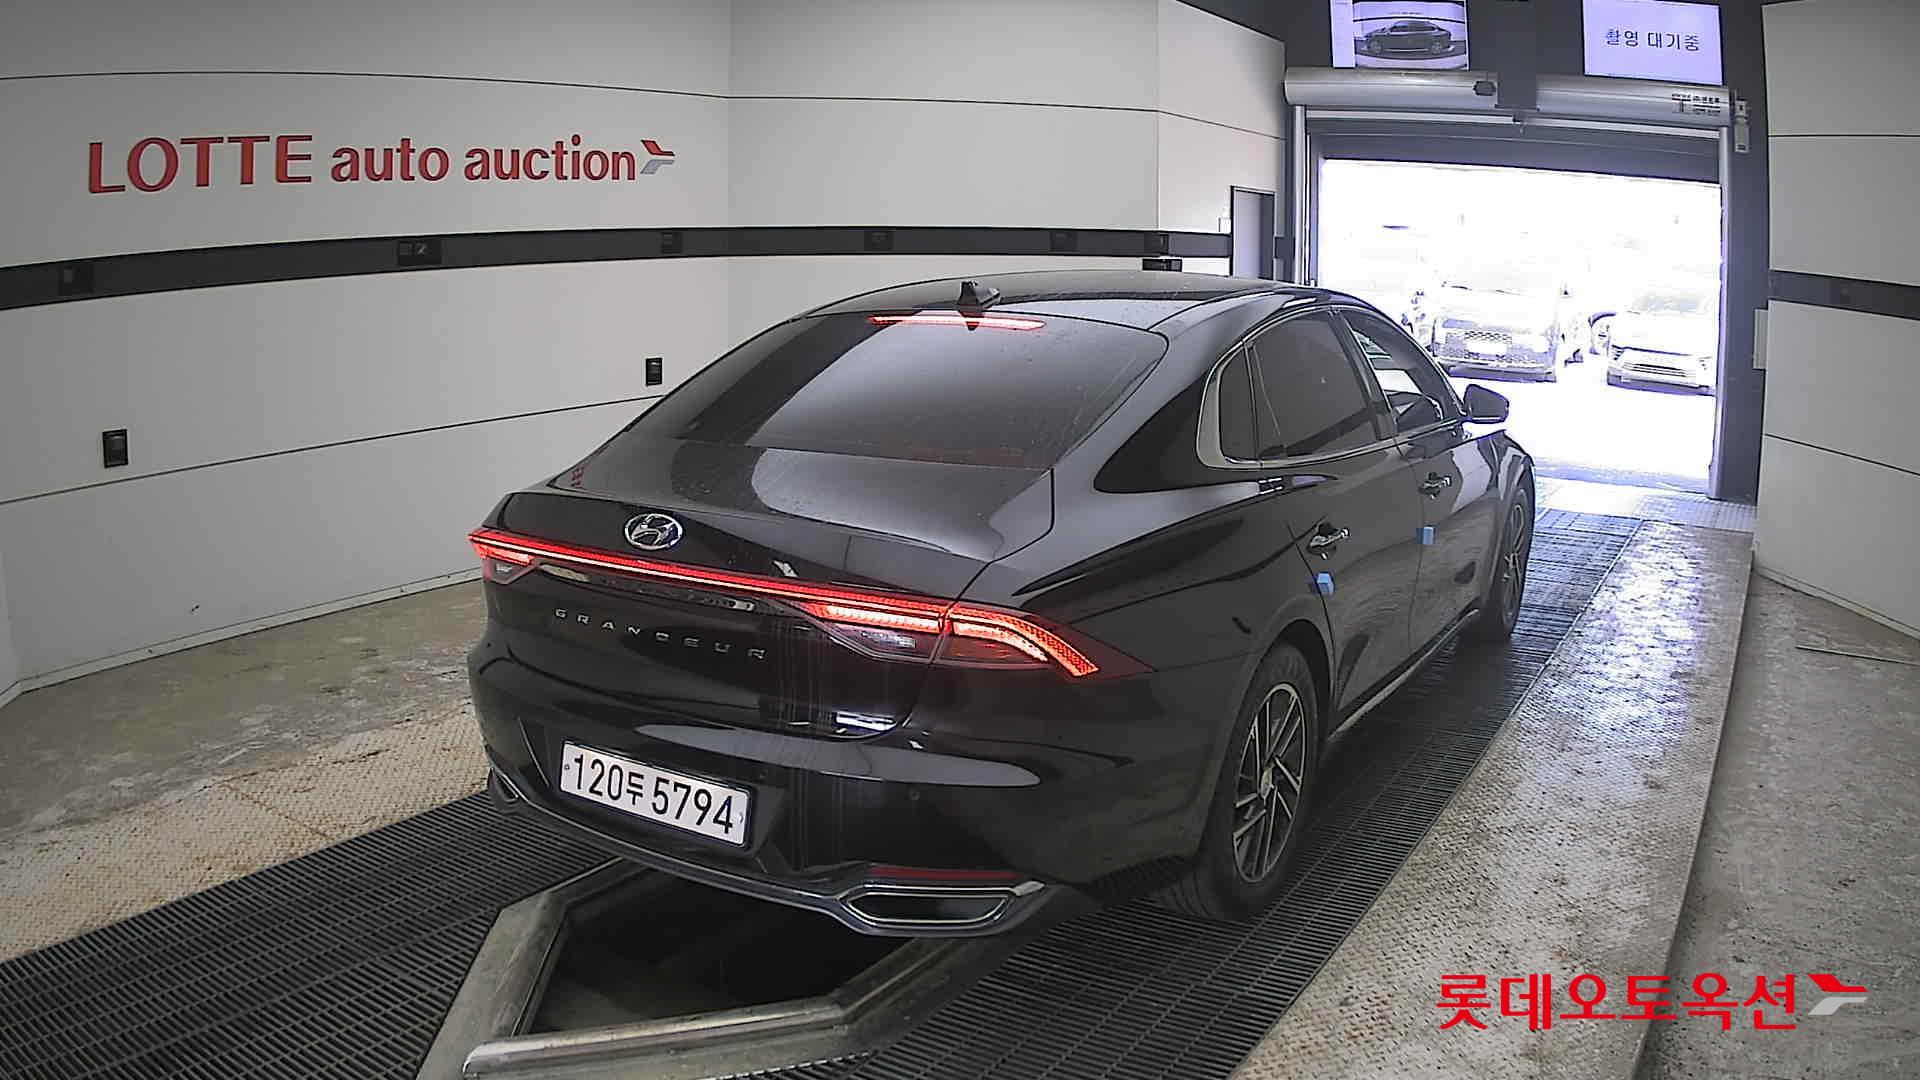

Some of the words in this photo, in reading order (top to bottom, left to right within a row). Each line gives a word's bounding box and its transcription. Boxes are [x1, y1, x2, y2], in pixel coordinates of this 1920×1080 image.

[1647, 31, 1700, 52] 대기중
[88, 134, 313, 194] LOTTE
[330, 137, 450, 183] auto
[463, 133, 637, 182] auction
[554, 607, 767, 661] GRANDEUR
[651, 775, 734, 835] 5794
